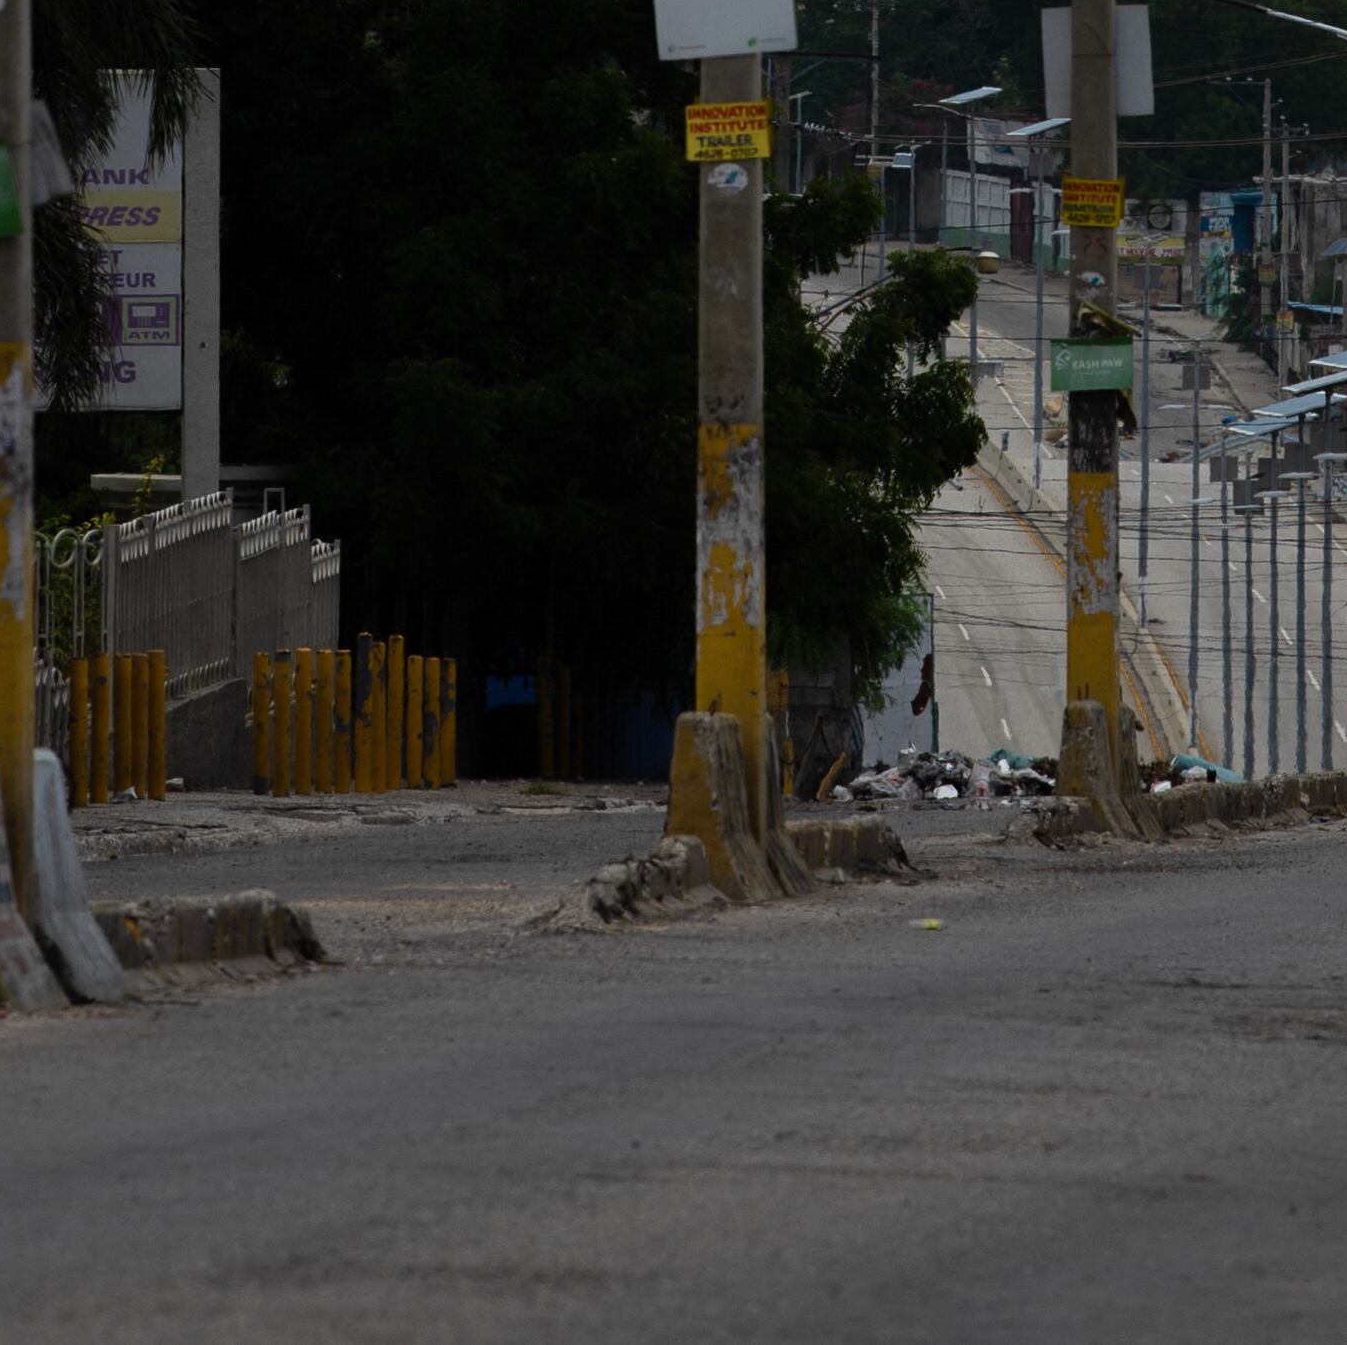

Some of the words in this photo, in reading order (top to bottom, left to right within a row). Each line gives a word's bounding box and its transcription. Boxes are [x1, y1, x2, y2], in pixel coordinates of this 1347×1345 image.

[688, 104, 768, 120] INNOVATION
[689, 119, 765, 133] INSTITUTE
[695, 133, 754, 148] TRAILER
[82, 168, 150, 185] ANK
[128, 331, 171, 340] ATM
